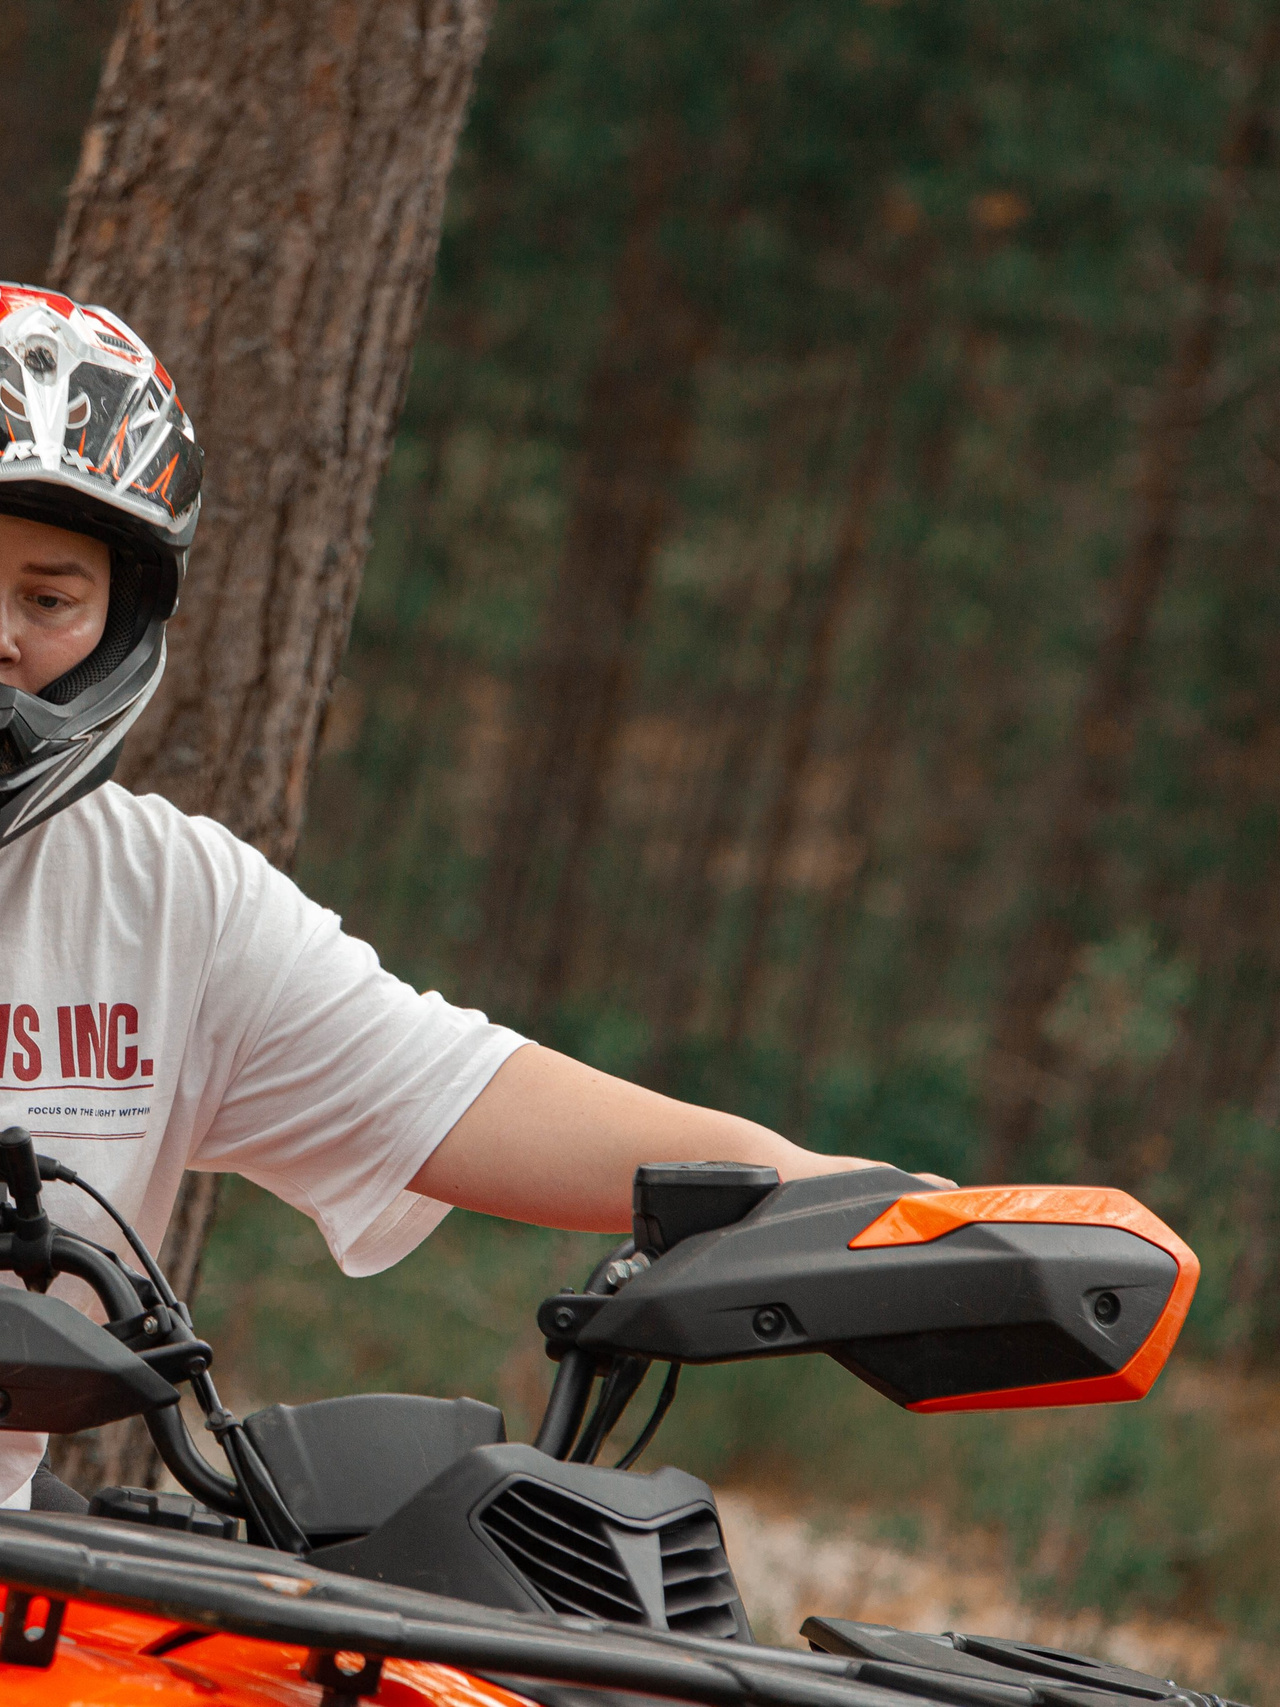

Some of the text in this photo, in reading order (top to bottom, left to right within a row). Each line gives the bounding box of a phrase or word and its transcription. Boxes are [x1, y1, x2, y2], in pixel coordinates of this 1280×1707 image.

[56, 1002, 154, 1081] INC.
[28, 1106, 62, 1115] FOCUS
[64, 1107, 78, 1115] ON
[80, 1108, 94, 1117] THE
[95, 1109, 116, 1117] LIGHT
